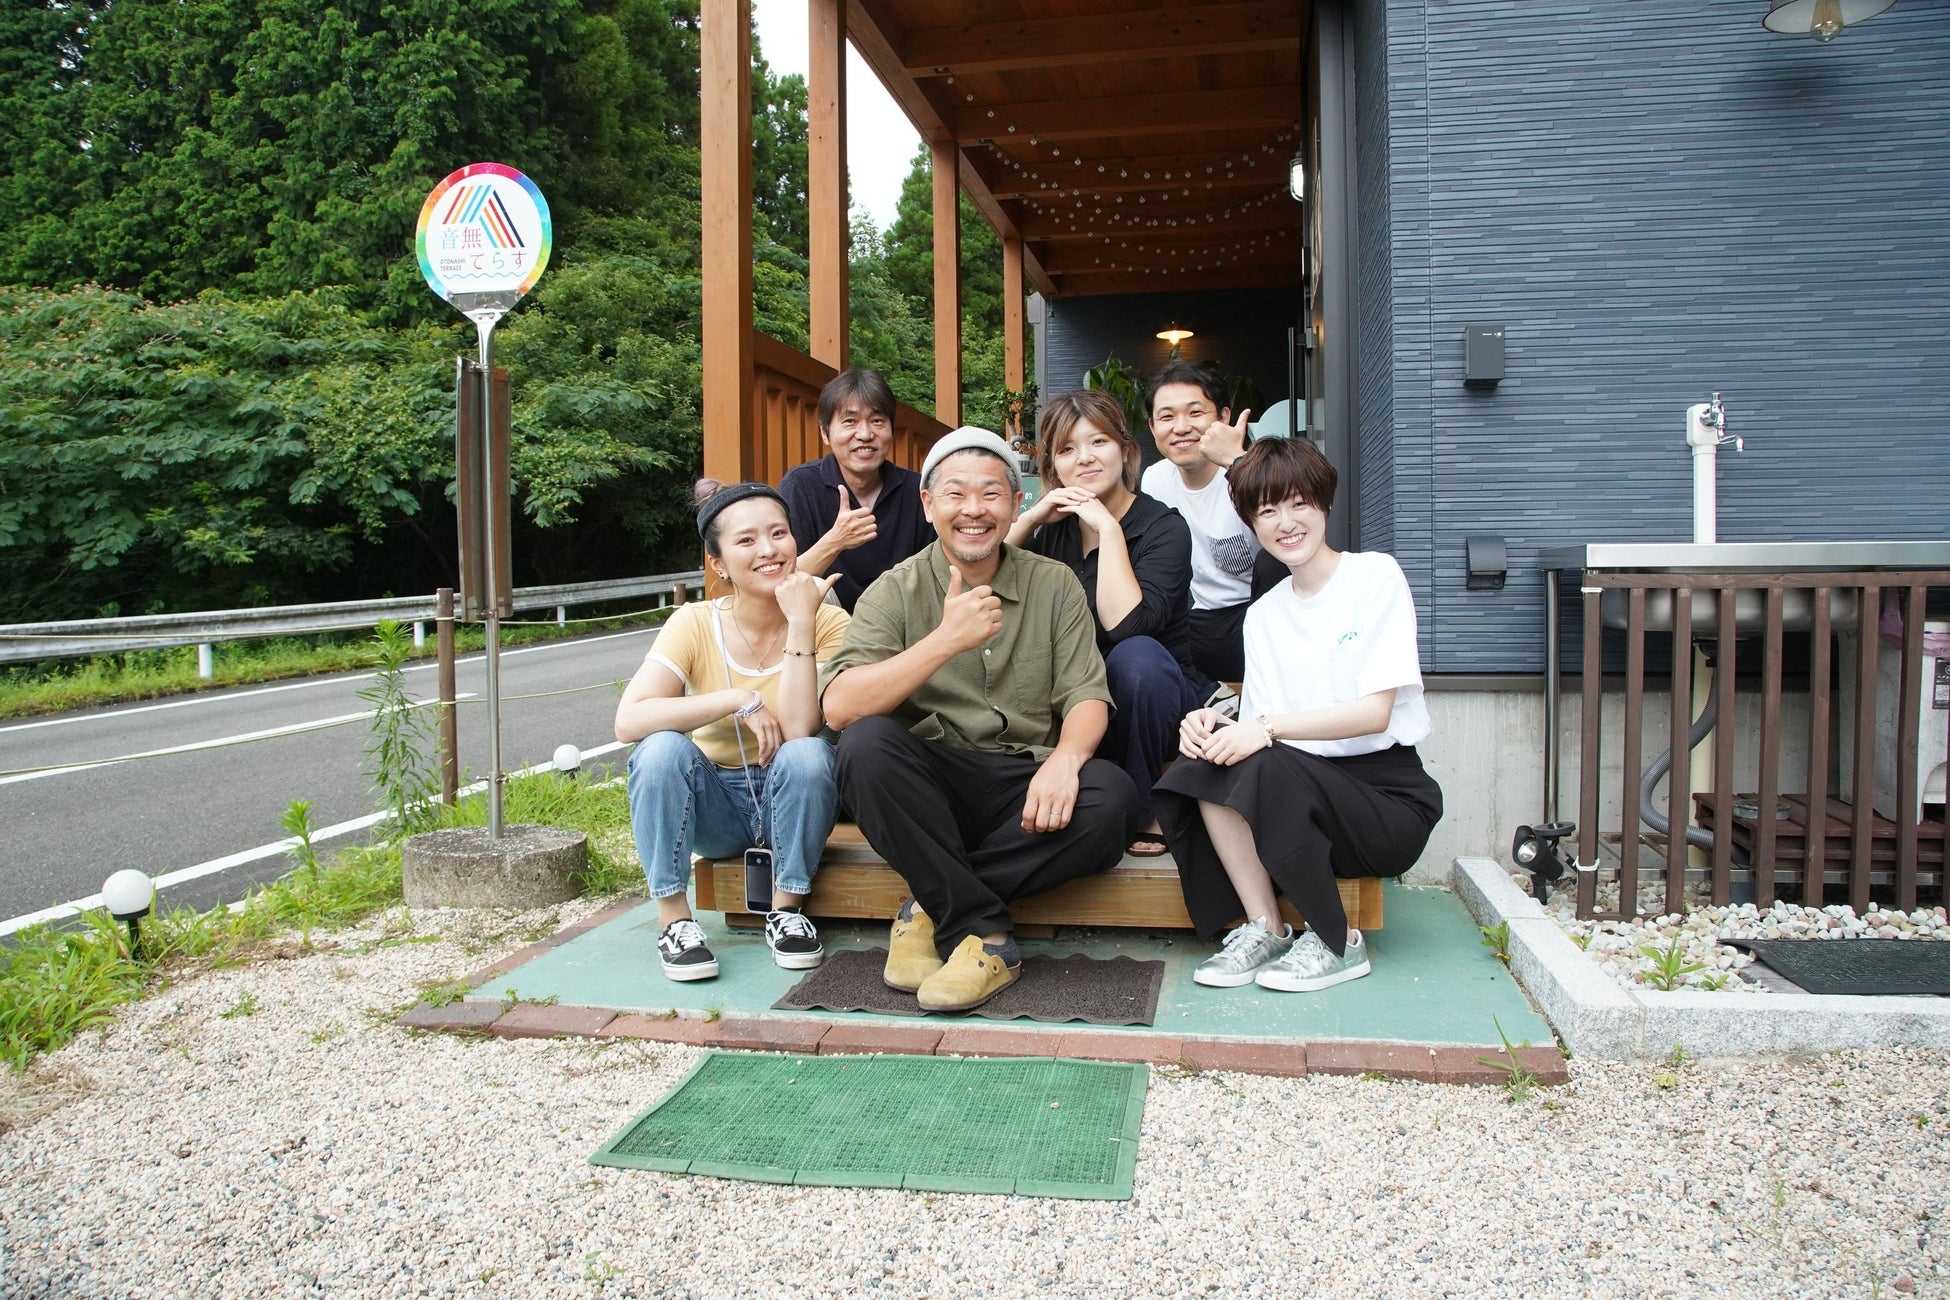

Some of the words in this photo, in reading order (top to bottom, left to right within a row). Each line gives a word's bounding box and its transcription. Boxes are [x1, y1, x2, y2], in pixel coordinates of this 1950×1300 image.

[440, 227, 482, 249] 音無
[470, 251, 527, 270] てらす
